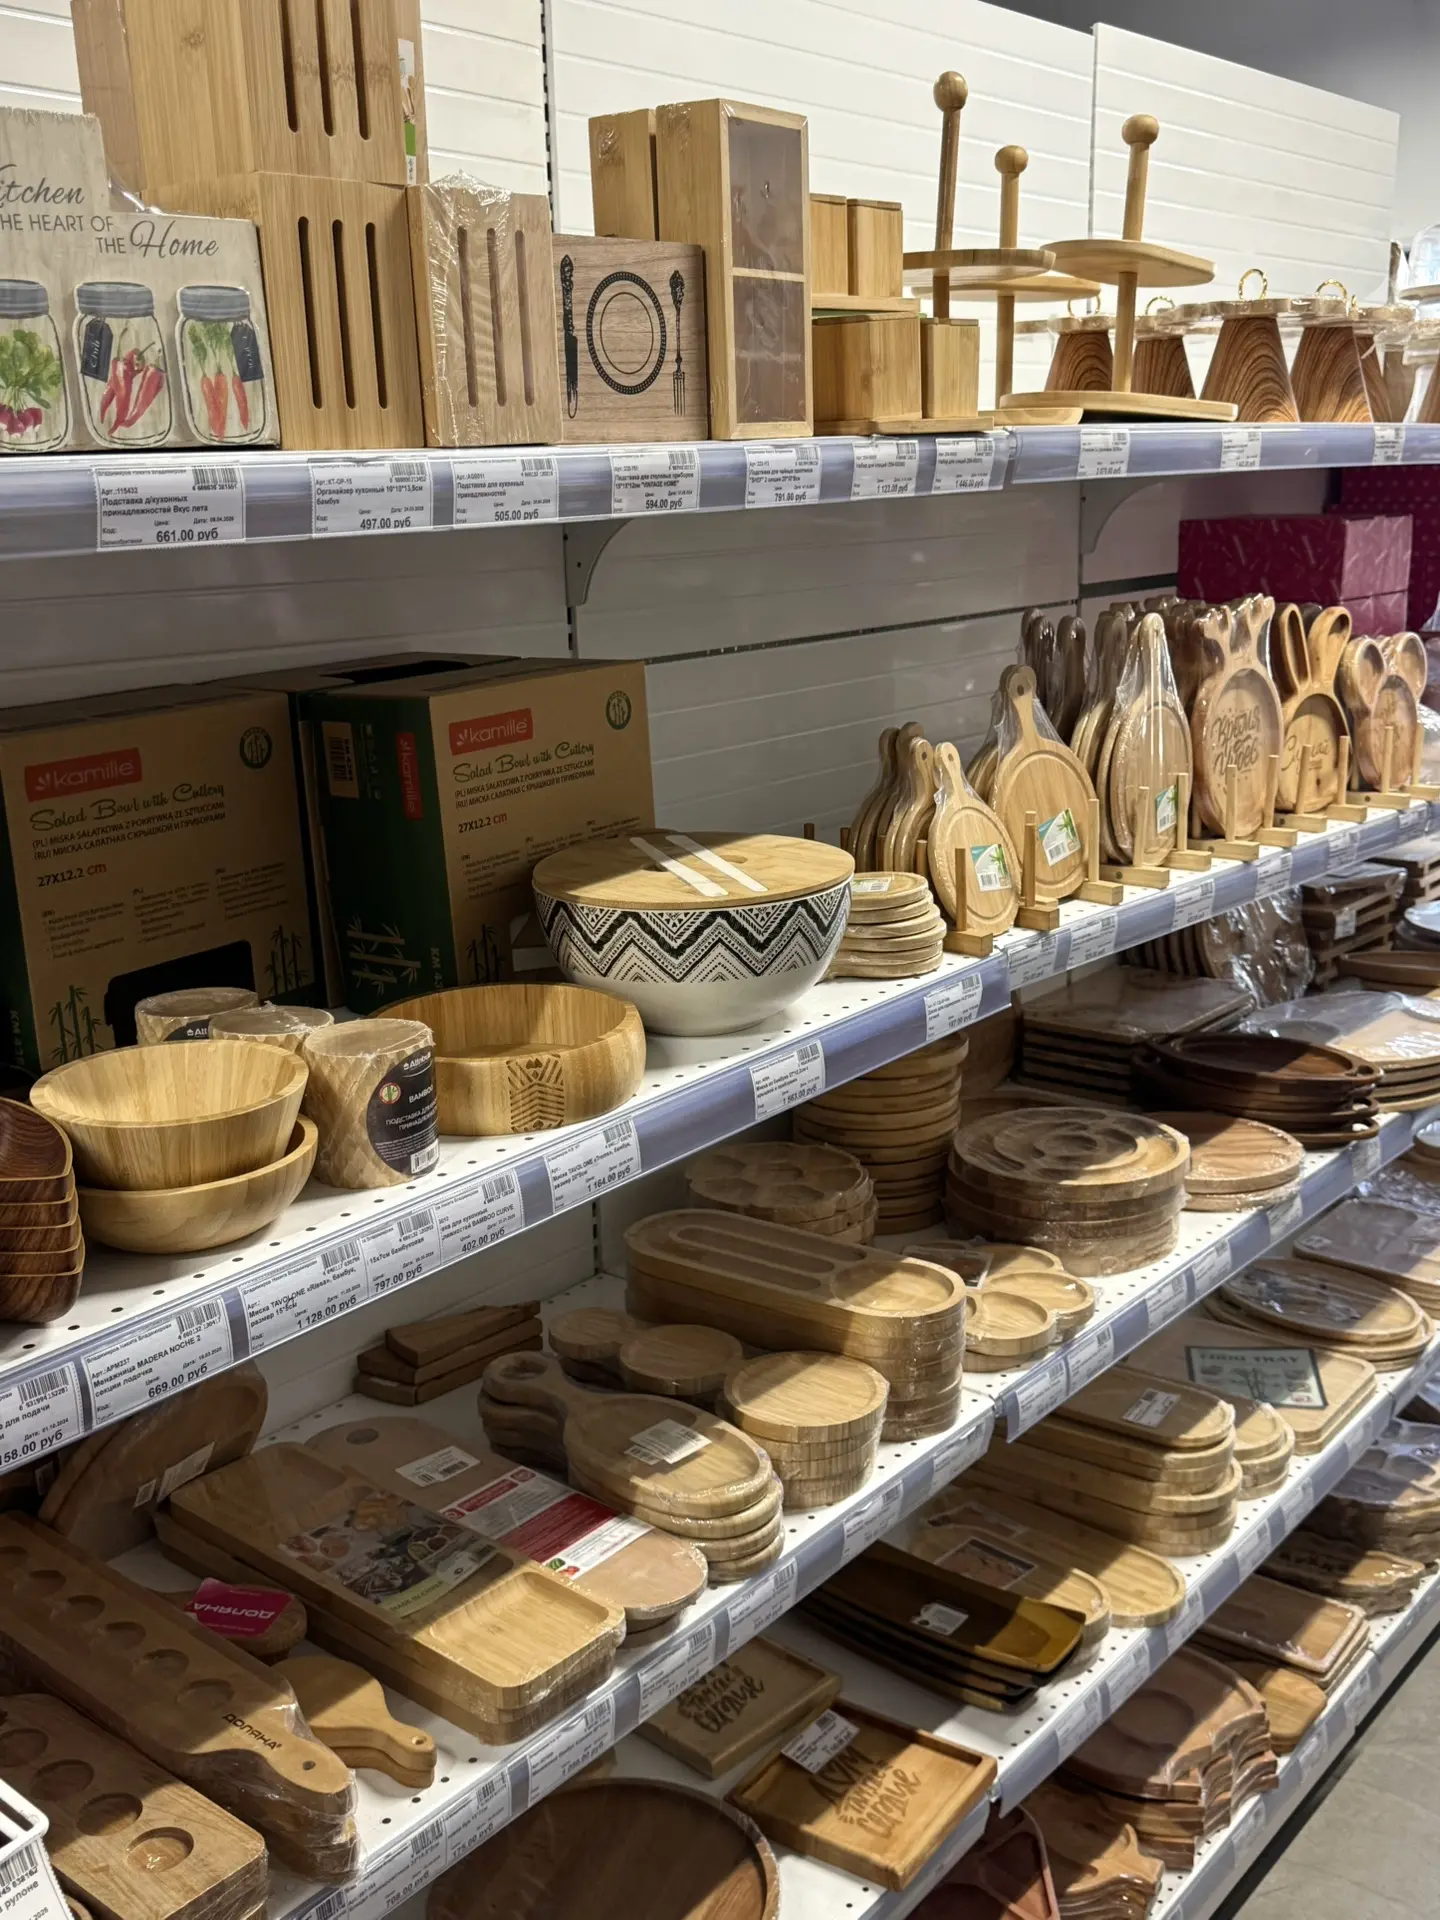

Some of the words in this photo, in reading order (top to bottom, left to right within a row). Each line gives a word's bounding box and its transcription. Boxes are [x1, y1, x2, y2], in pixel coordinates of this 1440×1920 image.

[0, 163, 85, 208] itchen
[0, 213, 23, 231] HE
[28, 214, 84, 232] HEART
[90, 215, 114, 232] OF
[96, 236, 126, 254] THE
[130, 219, 219, 259] Home
[102, 497, 144, 506] Подставка
[145, 495, 188, 505] д/кухонных
[316, 488, 354, 496] Органайзер
[355, 486, 384, 495] кухонный
[316, 497, 340, 505] бамбук
[795, 492, 807, 502] руб
[102, 506, 171, 517] принадлежностей
[173, 505, 190, 514] Вкус
[645, 499, 668, 509] 594.00
[669, 498, 683, 509] руб
[360, 518, 391, 530] 497.00
[393, 516, 411, 528] руб
[494, 510, 521, 522] 505.00
[523, 509, 539, 520] руб
[156, 529, 194, 543] 661.00
[198, 527, 219, 541] руб
[469, 718, 529, 744] kamille
[452, 762, 494, 783] Salad
[495, 753, 532, 774] Bowl
[532, 749, 553, 765] with
[554, 741, 594, 760] Cutlery
[52, 759, 136, 789] kamille
[466, 784, 485, 796] MISKA
[30, 807, 87, 832] Salad
[89, 798, 139, 821] Bowl
[142, 791, 168, 810] with
[172, 783, 225, 803] Cutlery
[458, 816, 492, 834] 27X12.2
[493, 812, 508, 824] cm
[49, 832, 75, 846] MISKA
[52, 843, 82, 857] МИСКА
[83, 833, 125, 851] САЛАТНАЯ
[37, 867, 85, 888] 27X12.2
[87, 862, 108, 877] cm
[409, 1084, 434, 1104] BAMBOO
[385, 1109, 421, 1126] ПОДСТАВКА
[593, 1172, 616, 1189] 164.00
[617, 1164, 632, 1178] руб
[442, 1224, 471, 1241] лежностей
[472, 1212, 496, 1228] BAMBOO
[496, 1203, 515, 1217] CURVE
[462, 1208, 488, 1224] кухонных
[391, 1238, 424, 1256] бамбуковая
[461, 1233, 488, 1253] 402.00
[489, 1226, 506, 1242] руб
[374, 1273, 403, 1293] 797.00
[405, 1263, 423, 1281] руб
[249, 1305, 270, 1319] Миска
[332, 1266, 357, 1281] бамбук,
[305, 1303, 337, 1325] 128.00
[338, 1294, 357, 1312] руб
[250, 1314, 275, 1328] размер
[93, 1364, 136, 1389] Менажница
[136, 1351, 169, 1371] MADERA
[169, 1340, 195, 1355] NOCHE
[95, 1381, 121, 1398] секции
[122, 1367, 154, 1389] лодочка
[147, 1375, 185, 1399] 669.00
[187, 1361, 209, 1382] руб
[5, 1416, 21, 1428] для
[21, 1404, 51, 1424] подачи
[96, 1402, 112, 1414] Код:
[40, 1429, 63, 1451] руб
[193, 1602, 277, 1620] ДОЛЯНА
[221, 1713, 279, 1751] ДОЛЯНА
[4, 1879, 40, 1911] рулоне
